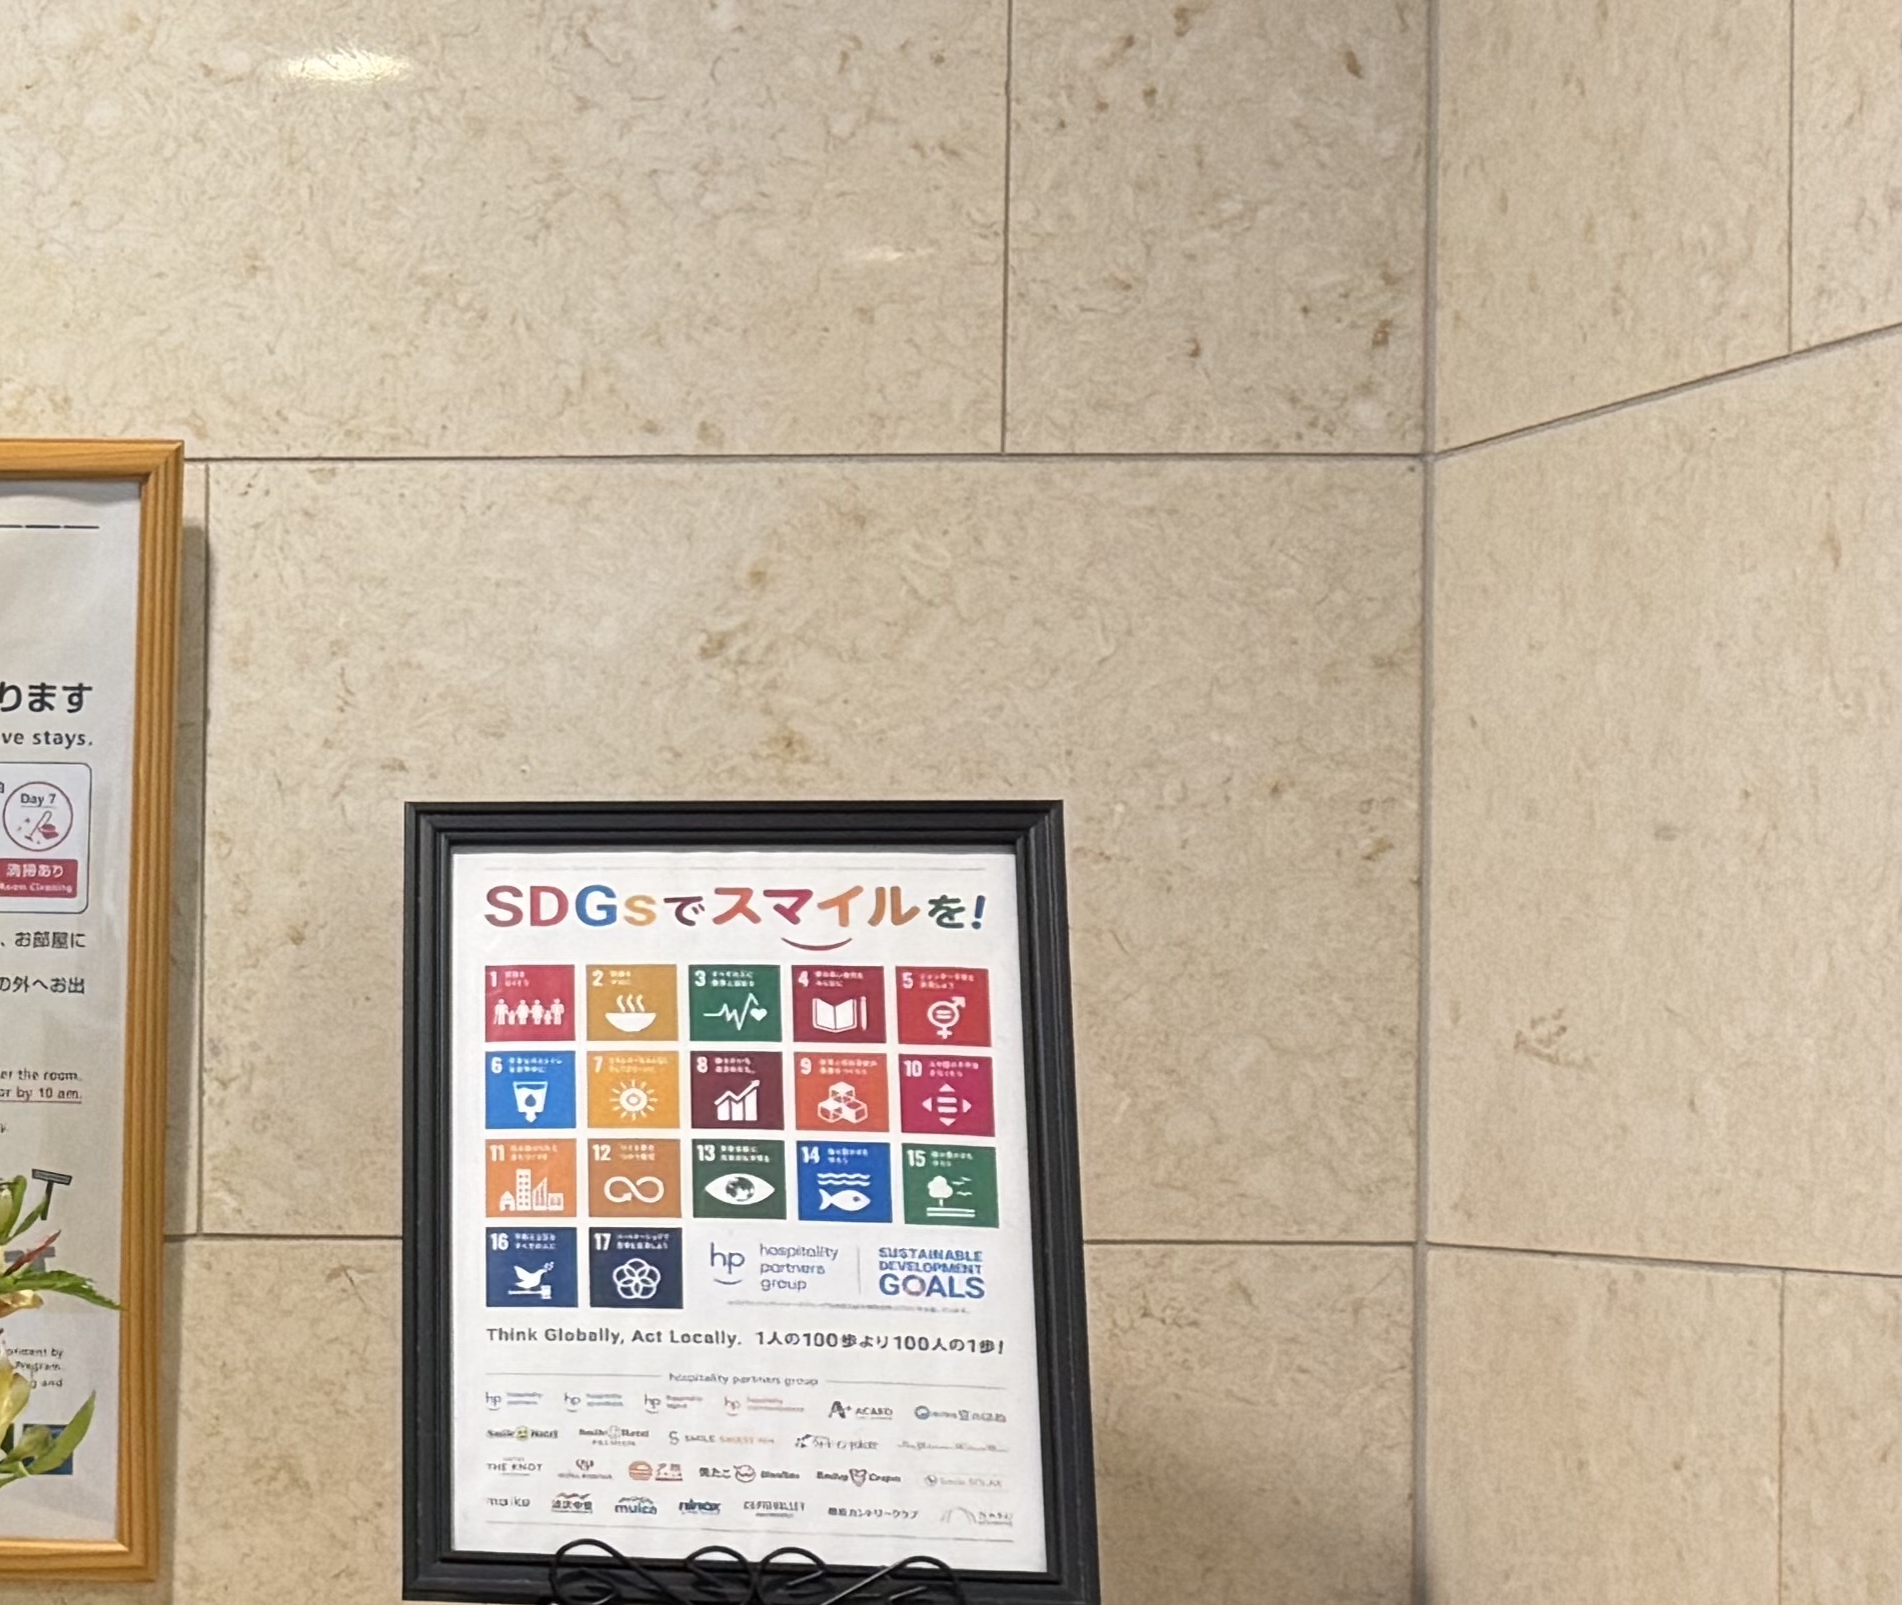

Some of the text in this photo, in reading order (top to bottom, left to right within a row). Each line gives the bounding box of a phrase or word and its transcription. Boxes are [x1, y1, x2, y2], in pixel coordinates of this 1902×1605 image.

[33, 731, 92, 750] stays.
[905, 1060, 922, 1077] 10
[490, 1146, 505, 1161] 11
[593, 1145, 611, 1160] 12
[697, 1145, 715, 1161] 13
[802, 1147, 820, 1163] 14
[907, 1150, 925, 1167] 15
[490, 1232, 509, 1250] 16
[595, 1233, 611, 1250] 17
[710, 1242, 745, 1272] hp
[879, 1274, 985, 1300] GOALS
[487, 1328, 741, 1348] Think Globally, Act Locally.
